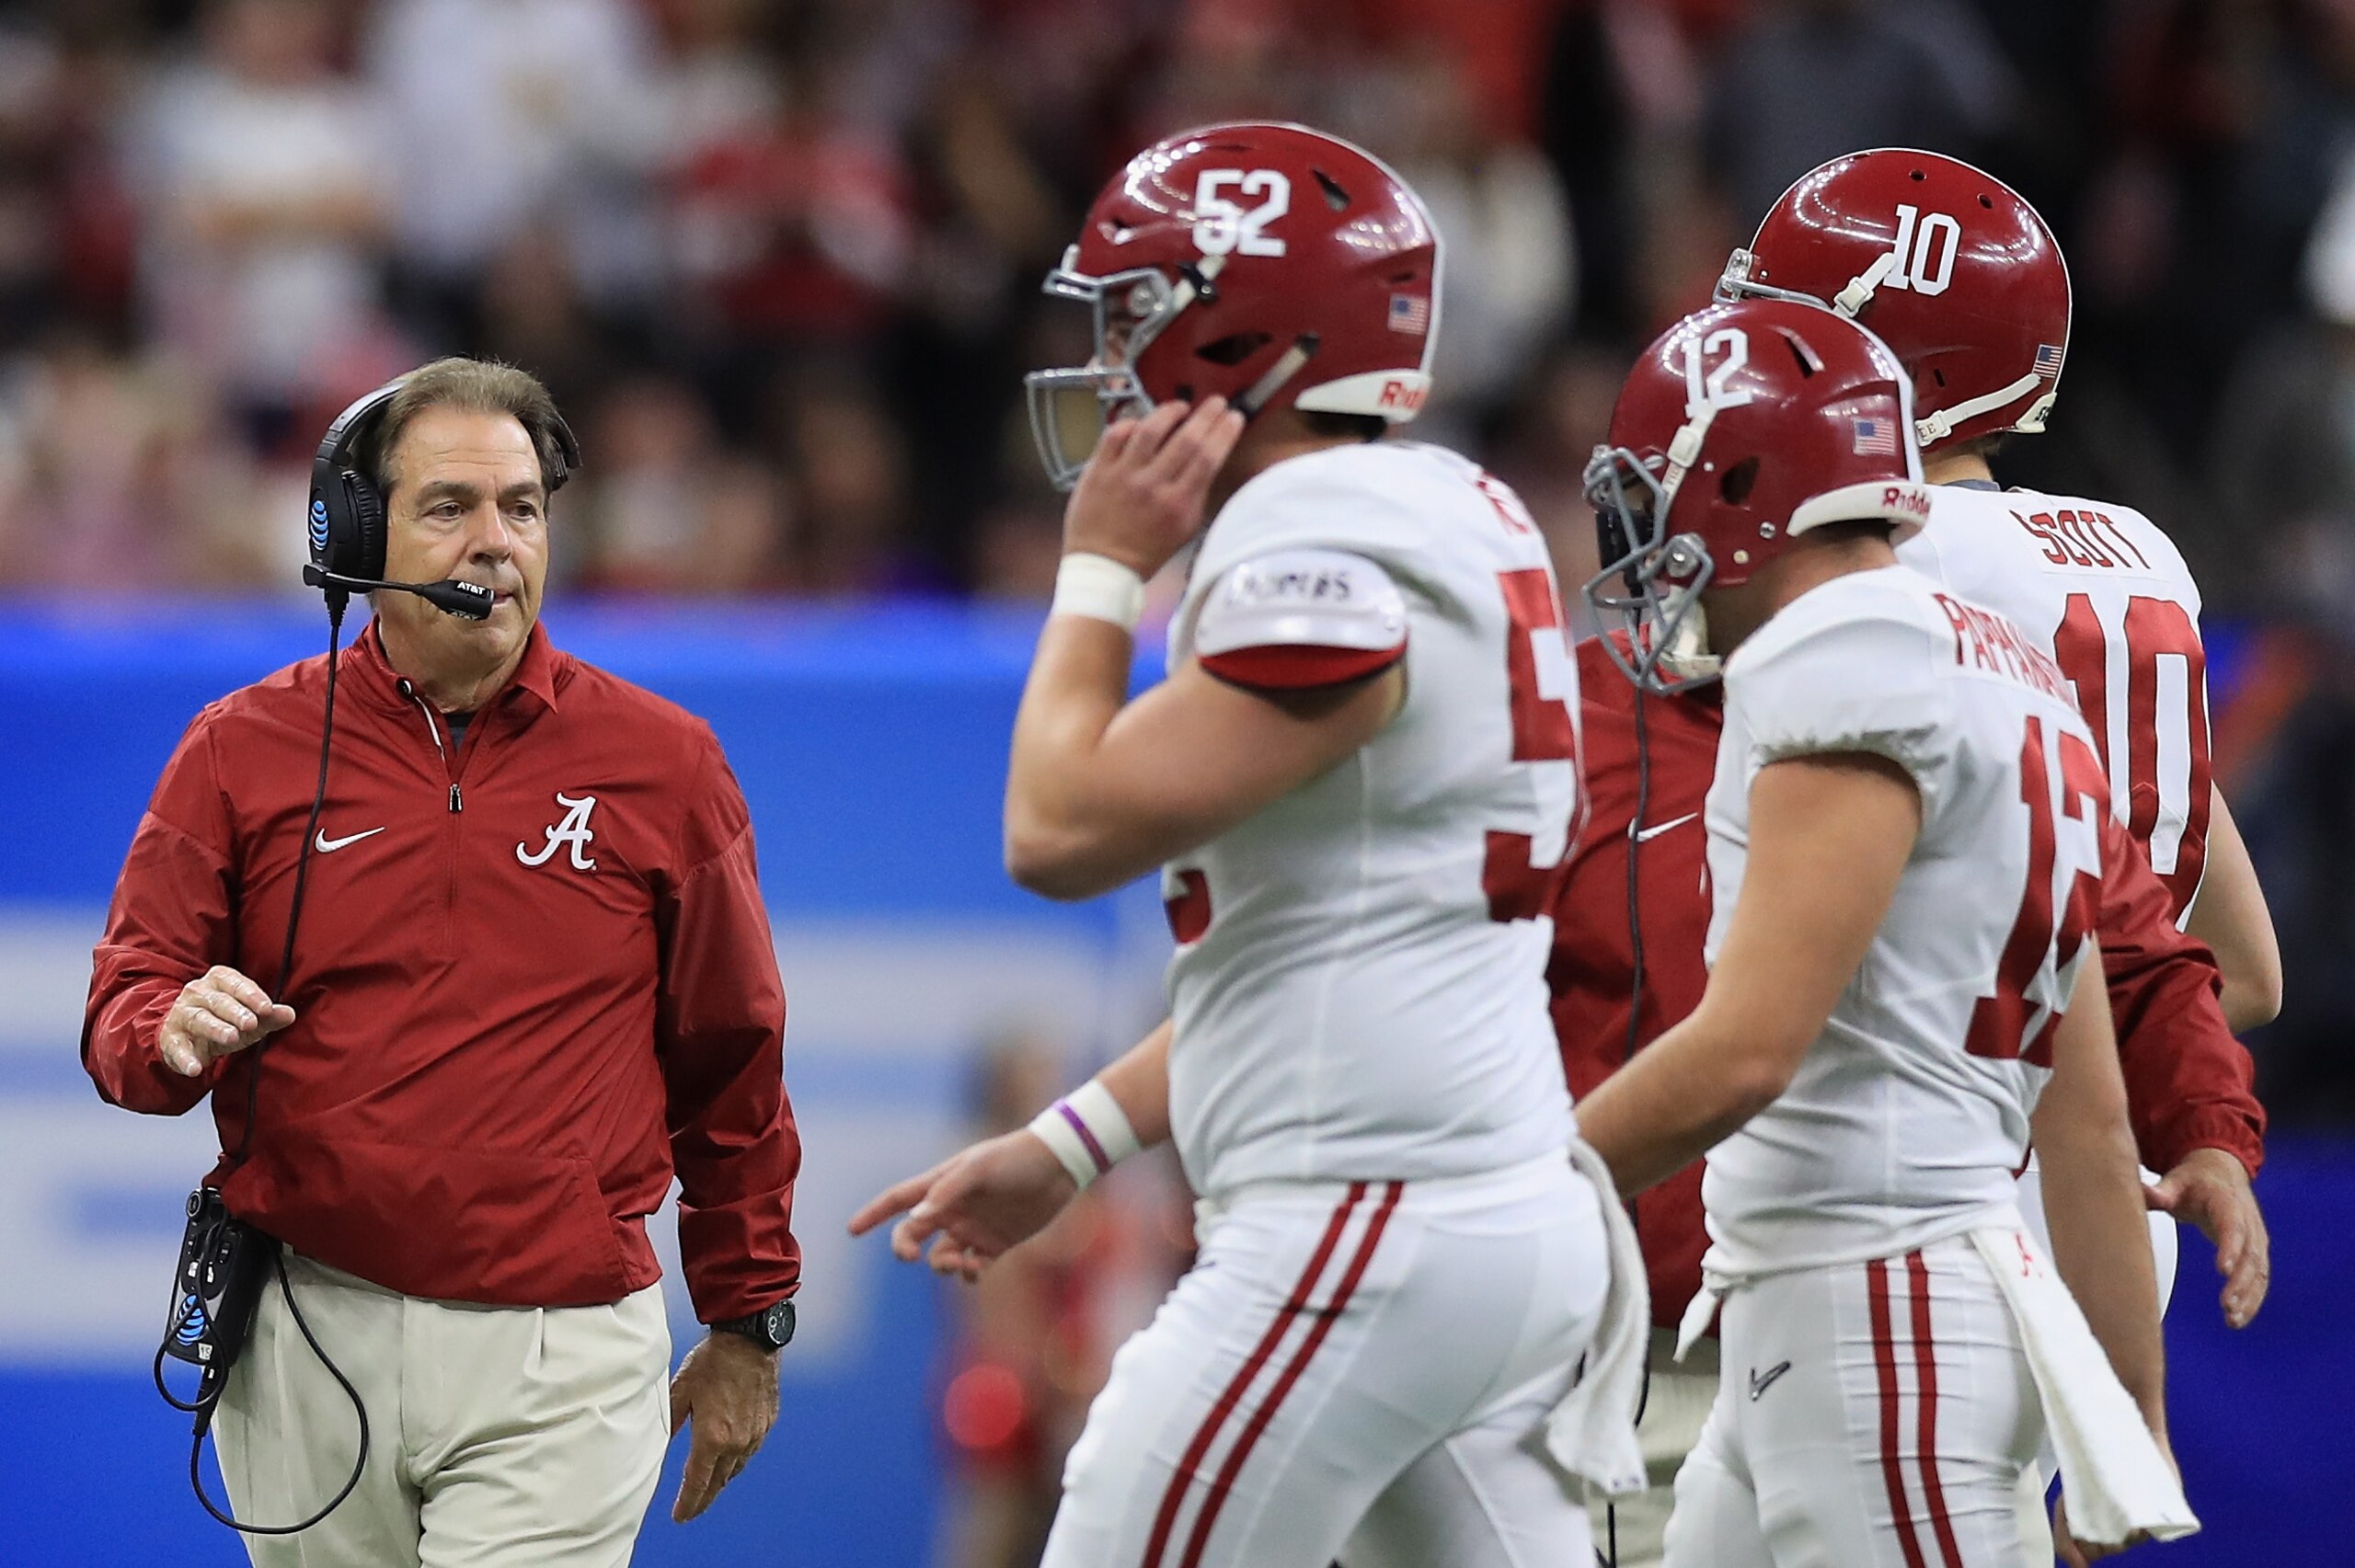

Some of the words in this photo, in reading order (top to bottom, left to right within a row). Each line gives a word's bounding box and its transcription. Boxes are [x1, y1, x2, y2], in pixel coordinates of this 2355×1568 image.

[1193, 168, 1290, 257] 52
[1883, 204, 1961, 296] 10
[1682, 327, 1752, 418] 12
[2009, 509, 2151, 569] SCOTT
[457, 582, 486, 595] AT&T
[1483, 568, 1591, 922] 5
[2053, 592, 2211, 927] 10
[516, 792, 596, 870] A
[1964, 715, 2110, 1067] 12
